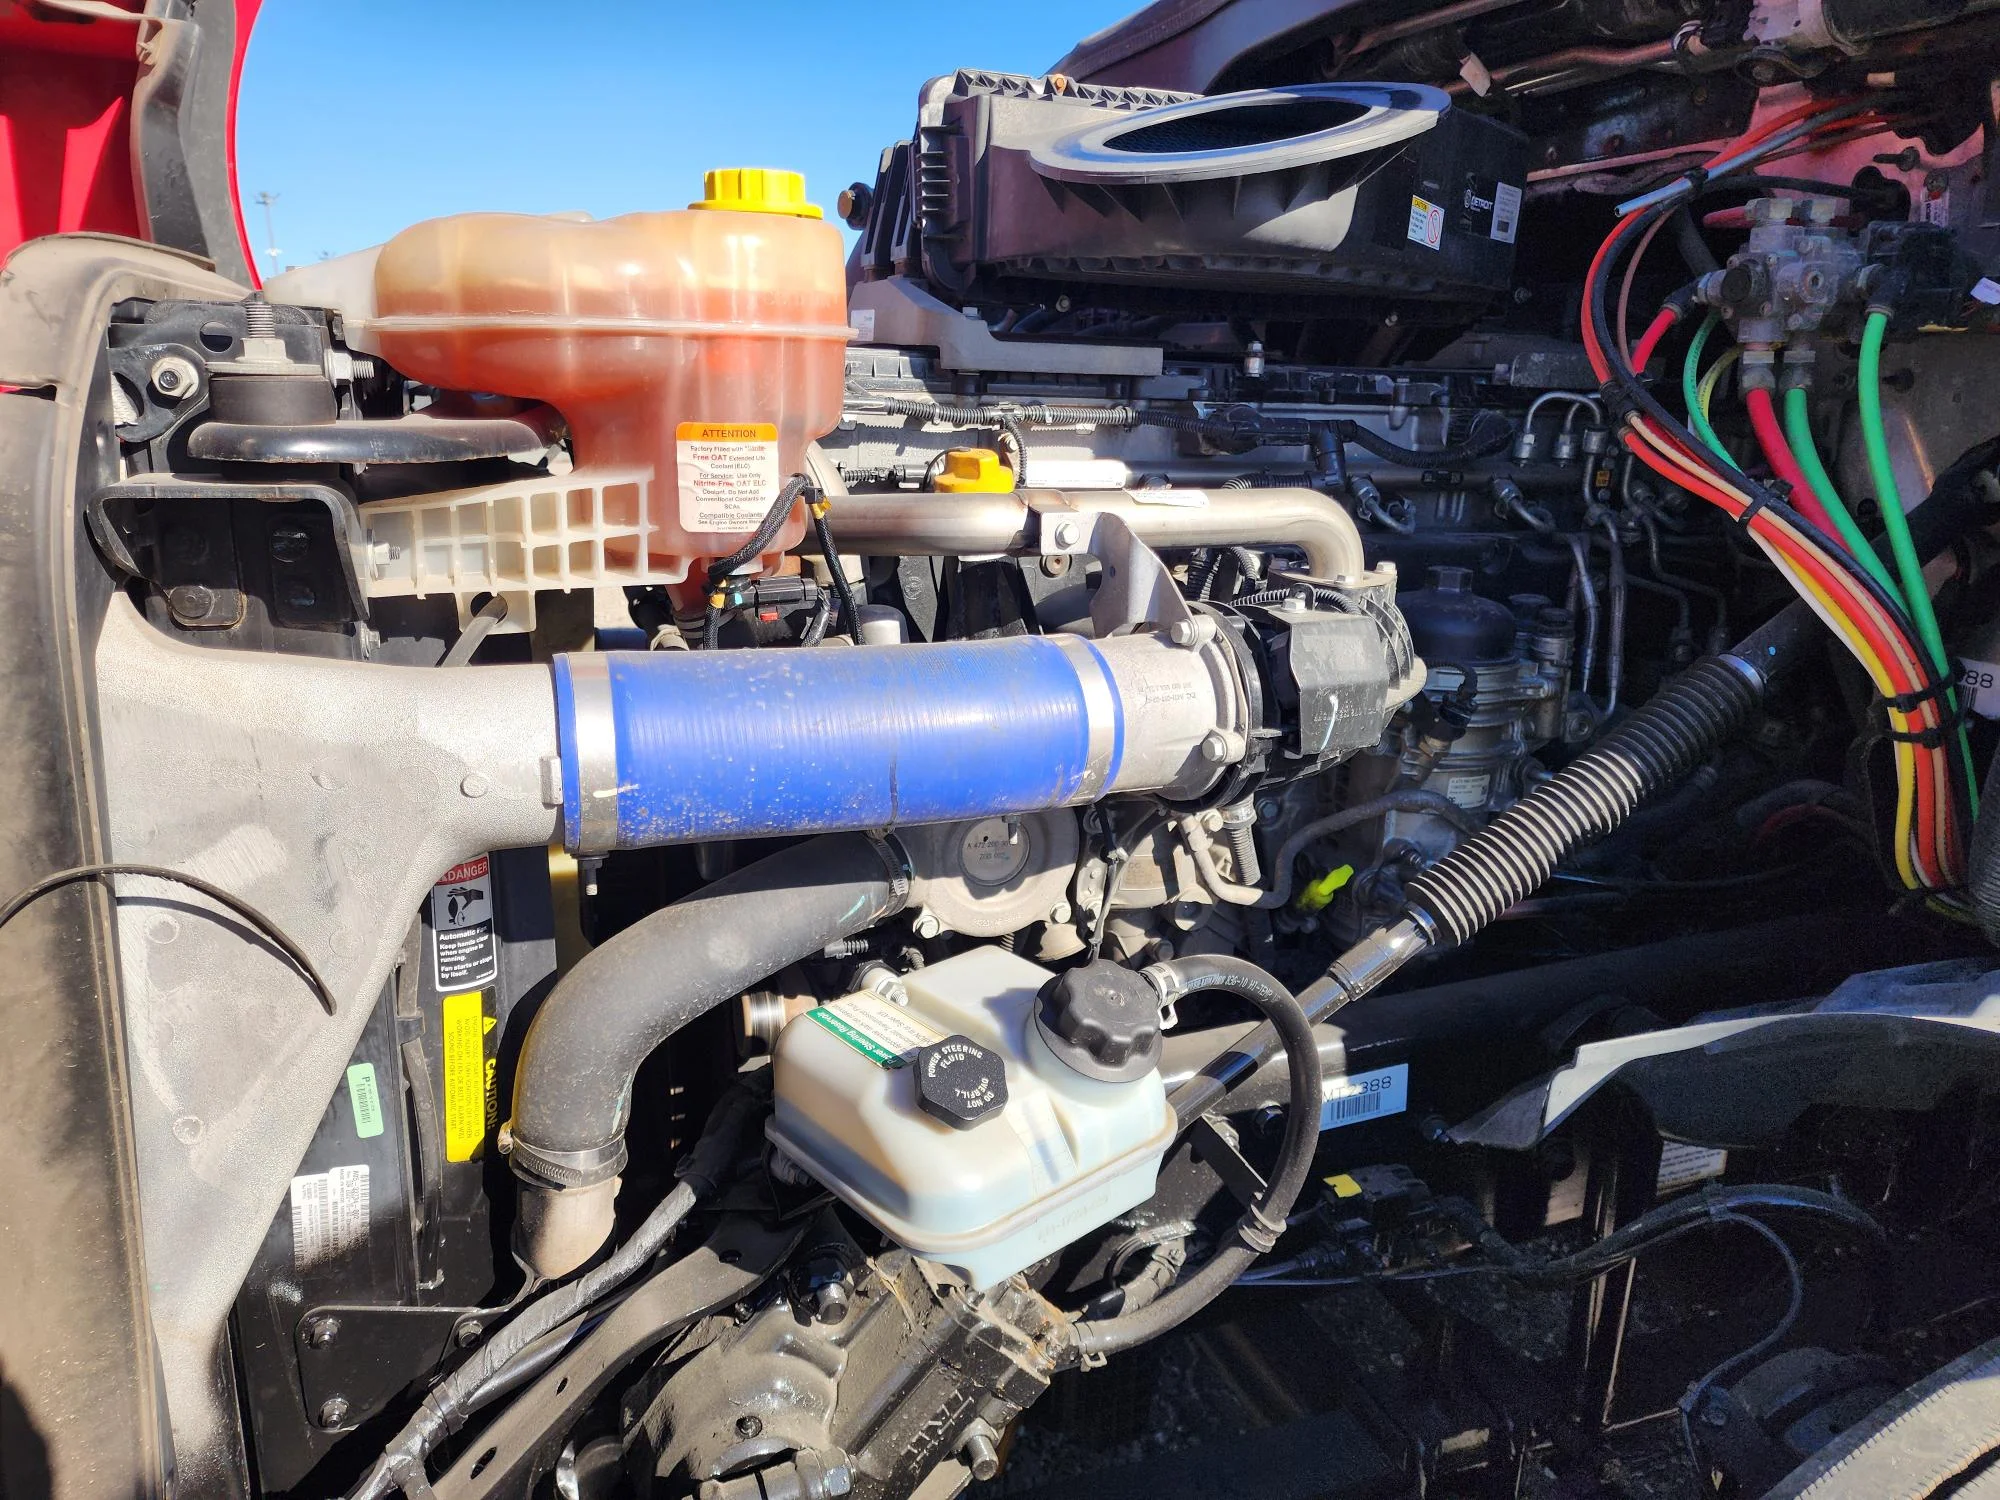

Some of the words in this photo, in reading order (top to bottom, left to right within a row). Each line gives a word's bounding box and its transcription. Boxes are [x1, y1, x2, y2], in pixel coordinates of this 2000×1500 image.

[1471, 196, 1493, 210] DETROIT
[702, 430, 756, 438] ATTENTION
[448, 862, 488, 881] DANGER
[439, 930, 476, 941] Automatic
[440, 943, 456, 951] Keep
[458, 939, 475, 948] hands
[458, 945, 477, 955] engine
[440, 955, 466, 963] running.
[450, 969, 468, 978] itself.
[454, 963, 472, 971] starts
[817, 1011, 850, 1031] Reservoir
[846, 1028, 876, 1052] Steering
[928, 1052, 942, 1078] POWER
[942, 1043, 983, 1060] STEERING
[940, 1053, 965, 1069] FLUID
[485, 1058, 497, 1130] CAUTION:
[954, 1076, 989, 1099] OVERFILL
[984, 1090, 995, 1103] DO
[966, 1098, 984, 1109] NOT
